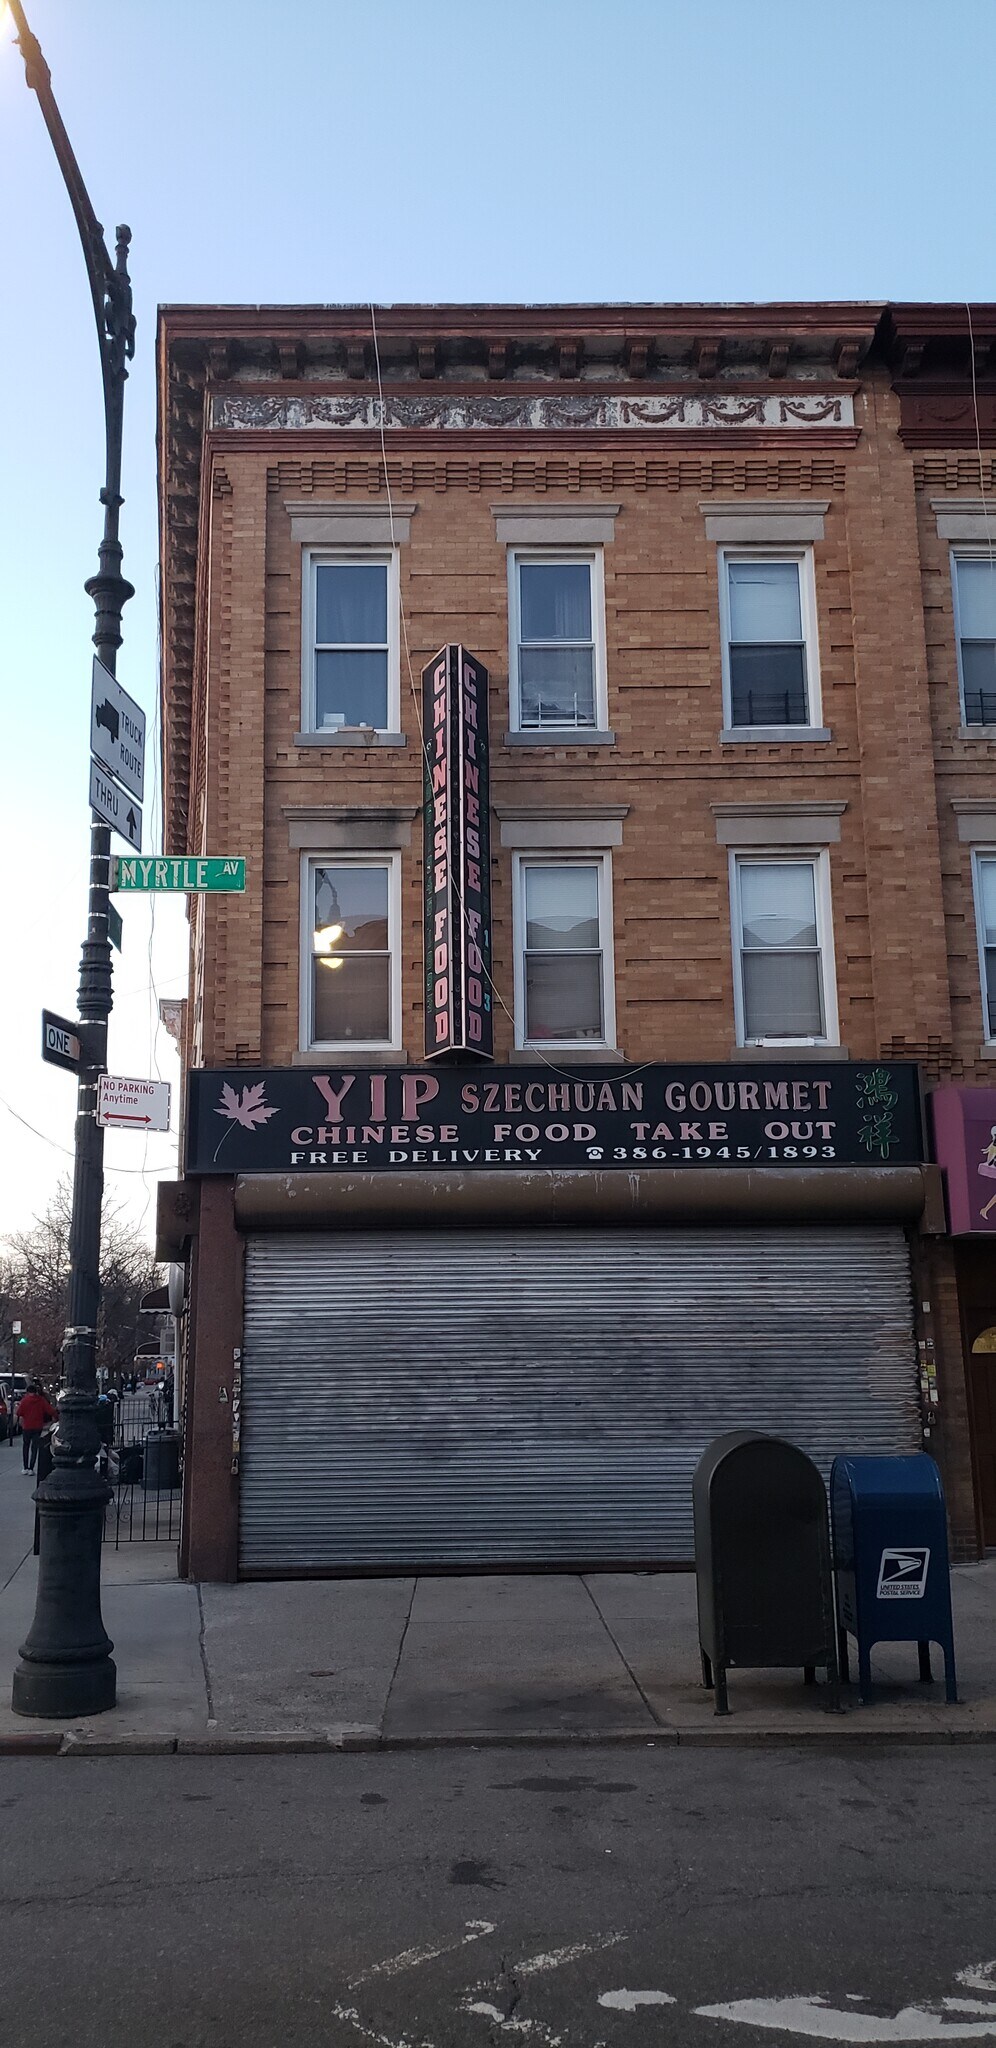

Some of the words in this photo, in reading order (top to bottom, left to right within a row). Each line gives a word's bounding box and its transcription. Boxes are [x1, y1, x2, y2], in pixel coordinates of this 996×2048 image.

[120, 710, 143, 749] TRUCK
[120, 742, 142, 779] ROUTE
[433, 660, 447, 893] CHINESE
[464, 662, 481, 893] CHINESE
[96, 776, 118, 816] THRU
[121, 860, 208, 888] MYRTLE
[223, 861, 239, 876] AV
[434, 912, 448, 1043] FOOD
[467, 908, 482, 1042] FOOD
[48, 1028, 70, 1054] ONE
[103, 1081, 116, 1092] NO
[118, 1082, 154, 1095] PARKING
[103, 1093, 139, 1105] Anytime
[311, 1074, 440, 1123] YIP
[460, 1082, 644, 1114] SZECHUAN
[664, 1080, 832, 1112] GOURMET
[290, 1125, 459, 1145] CHINESE
[493, 1123, 597, 1142] FOOD
[630, 1122, 729, 1141] TAKE
[764, 1121, 836, 1140] OUT
[290, 1151, 368, 1164] FREE
[389, 1148, 542, 1163] DELIVERY
[612, 1145, 837, 1160] 386-1945/1893
